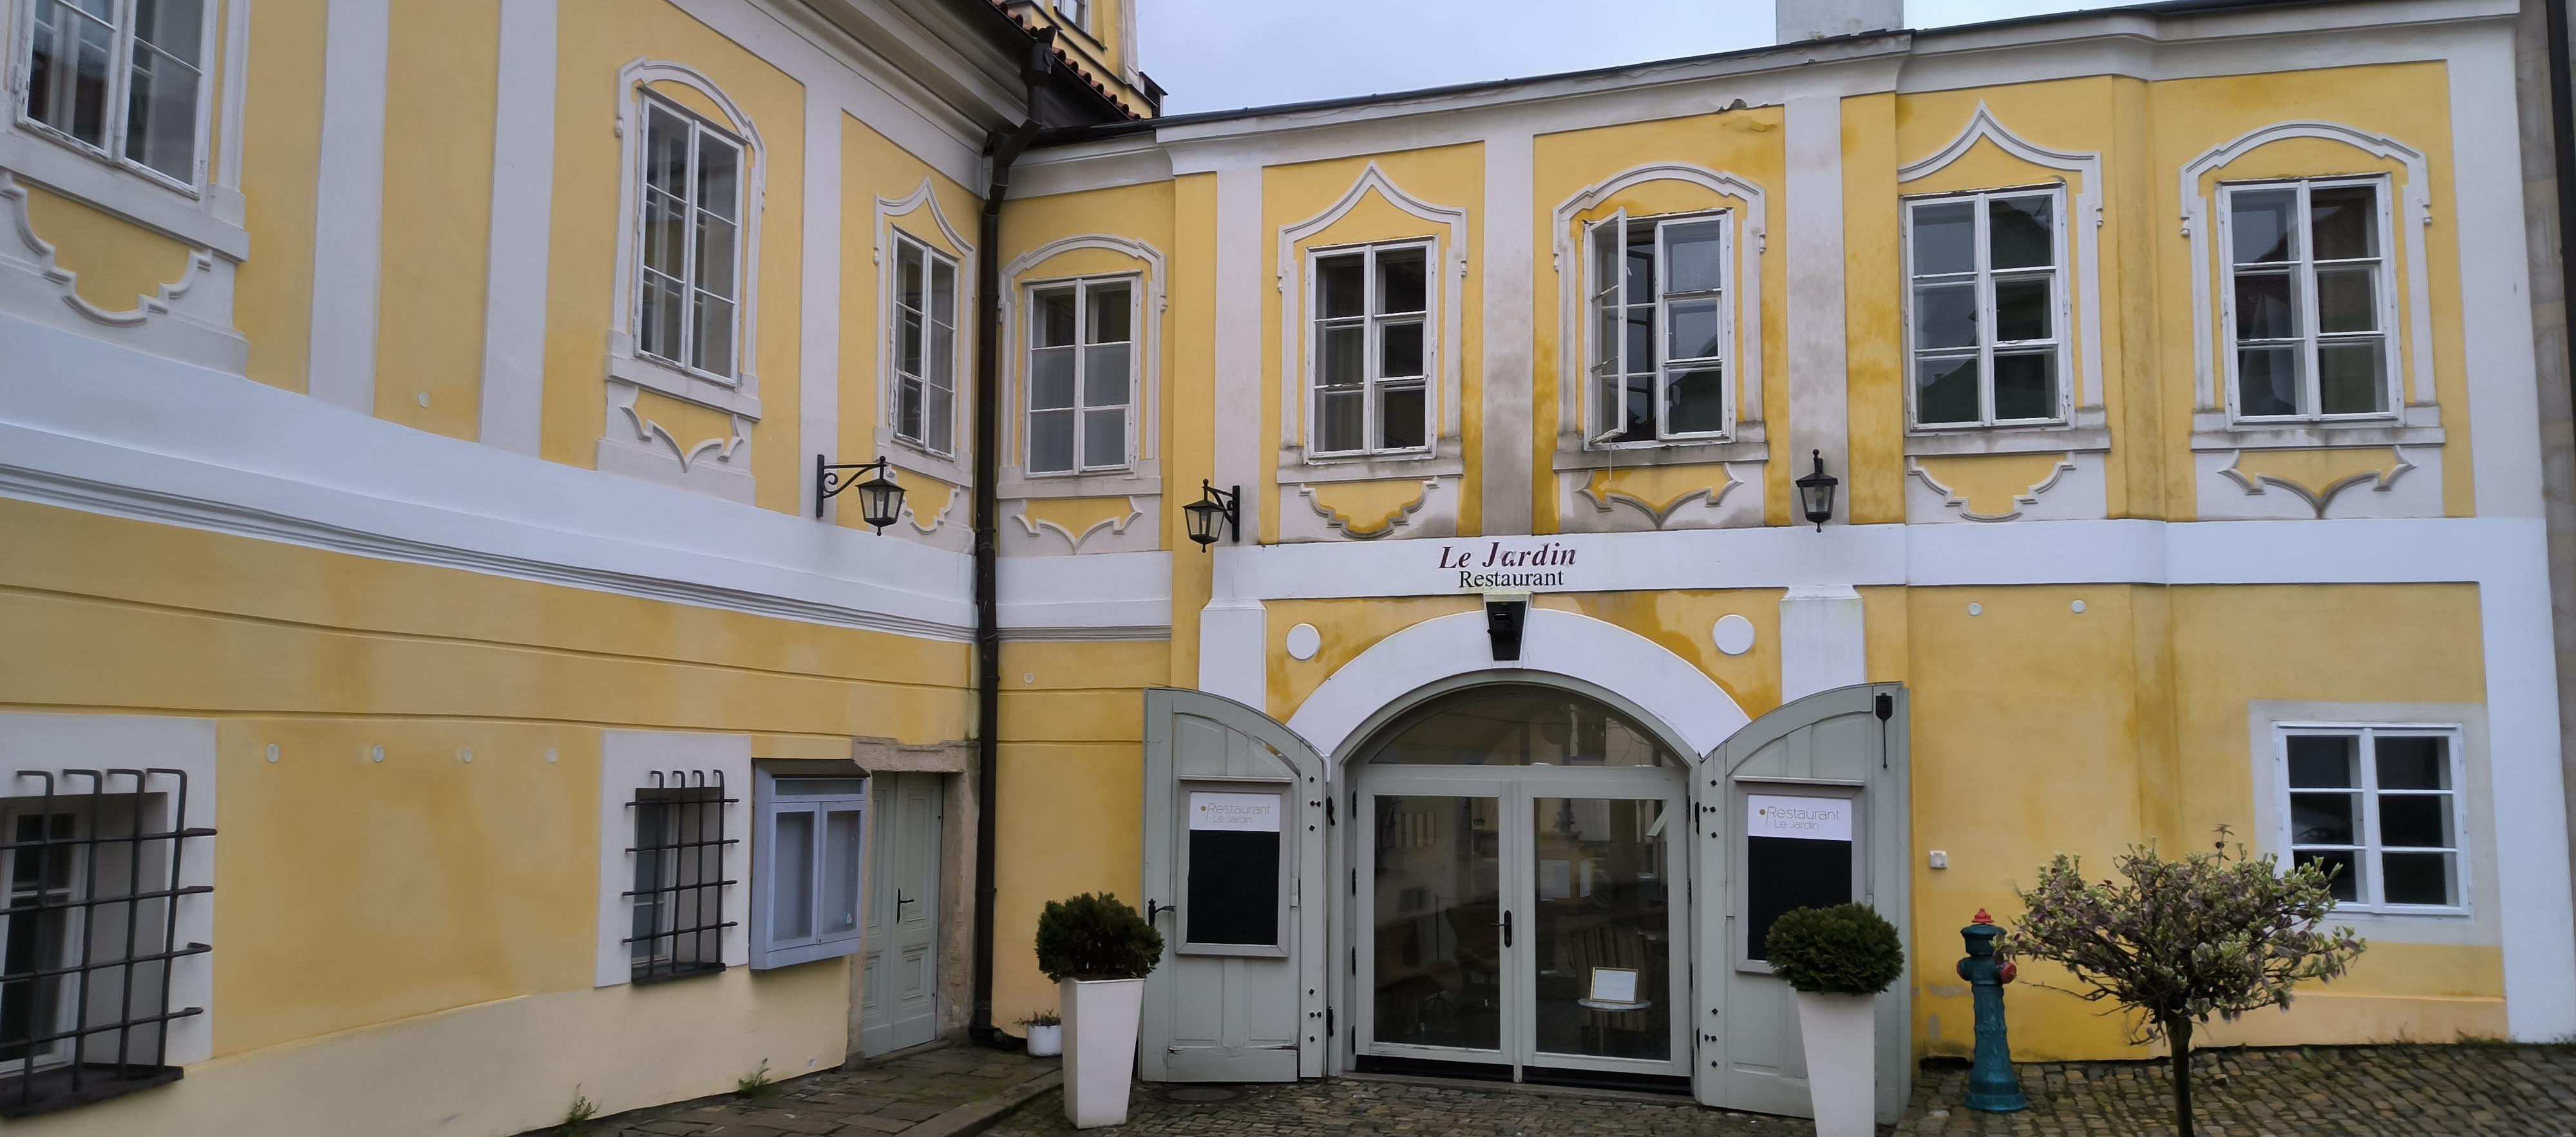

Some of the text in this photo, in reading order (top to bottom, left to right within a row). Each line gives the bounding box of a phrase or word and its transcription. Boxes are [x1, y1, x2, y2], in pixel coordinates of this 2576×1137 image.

[1437, 542, 1577, 569] Le Jardin
[1459, 570, 1564, 588] Restaurant
[1206, 803, 1271, 823] Restaurant
[1766, 806, 1841, 827] Restaurant
[1774, 819, 1819, 830] Le Jardin
